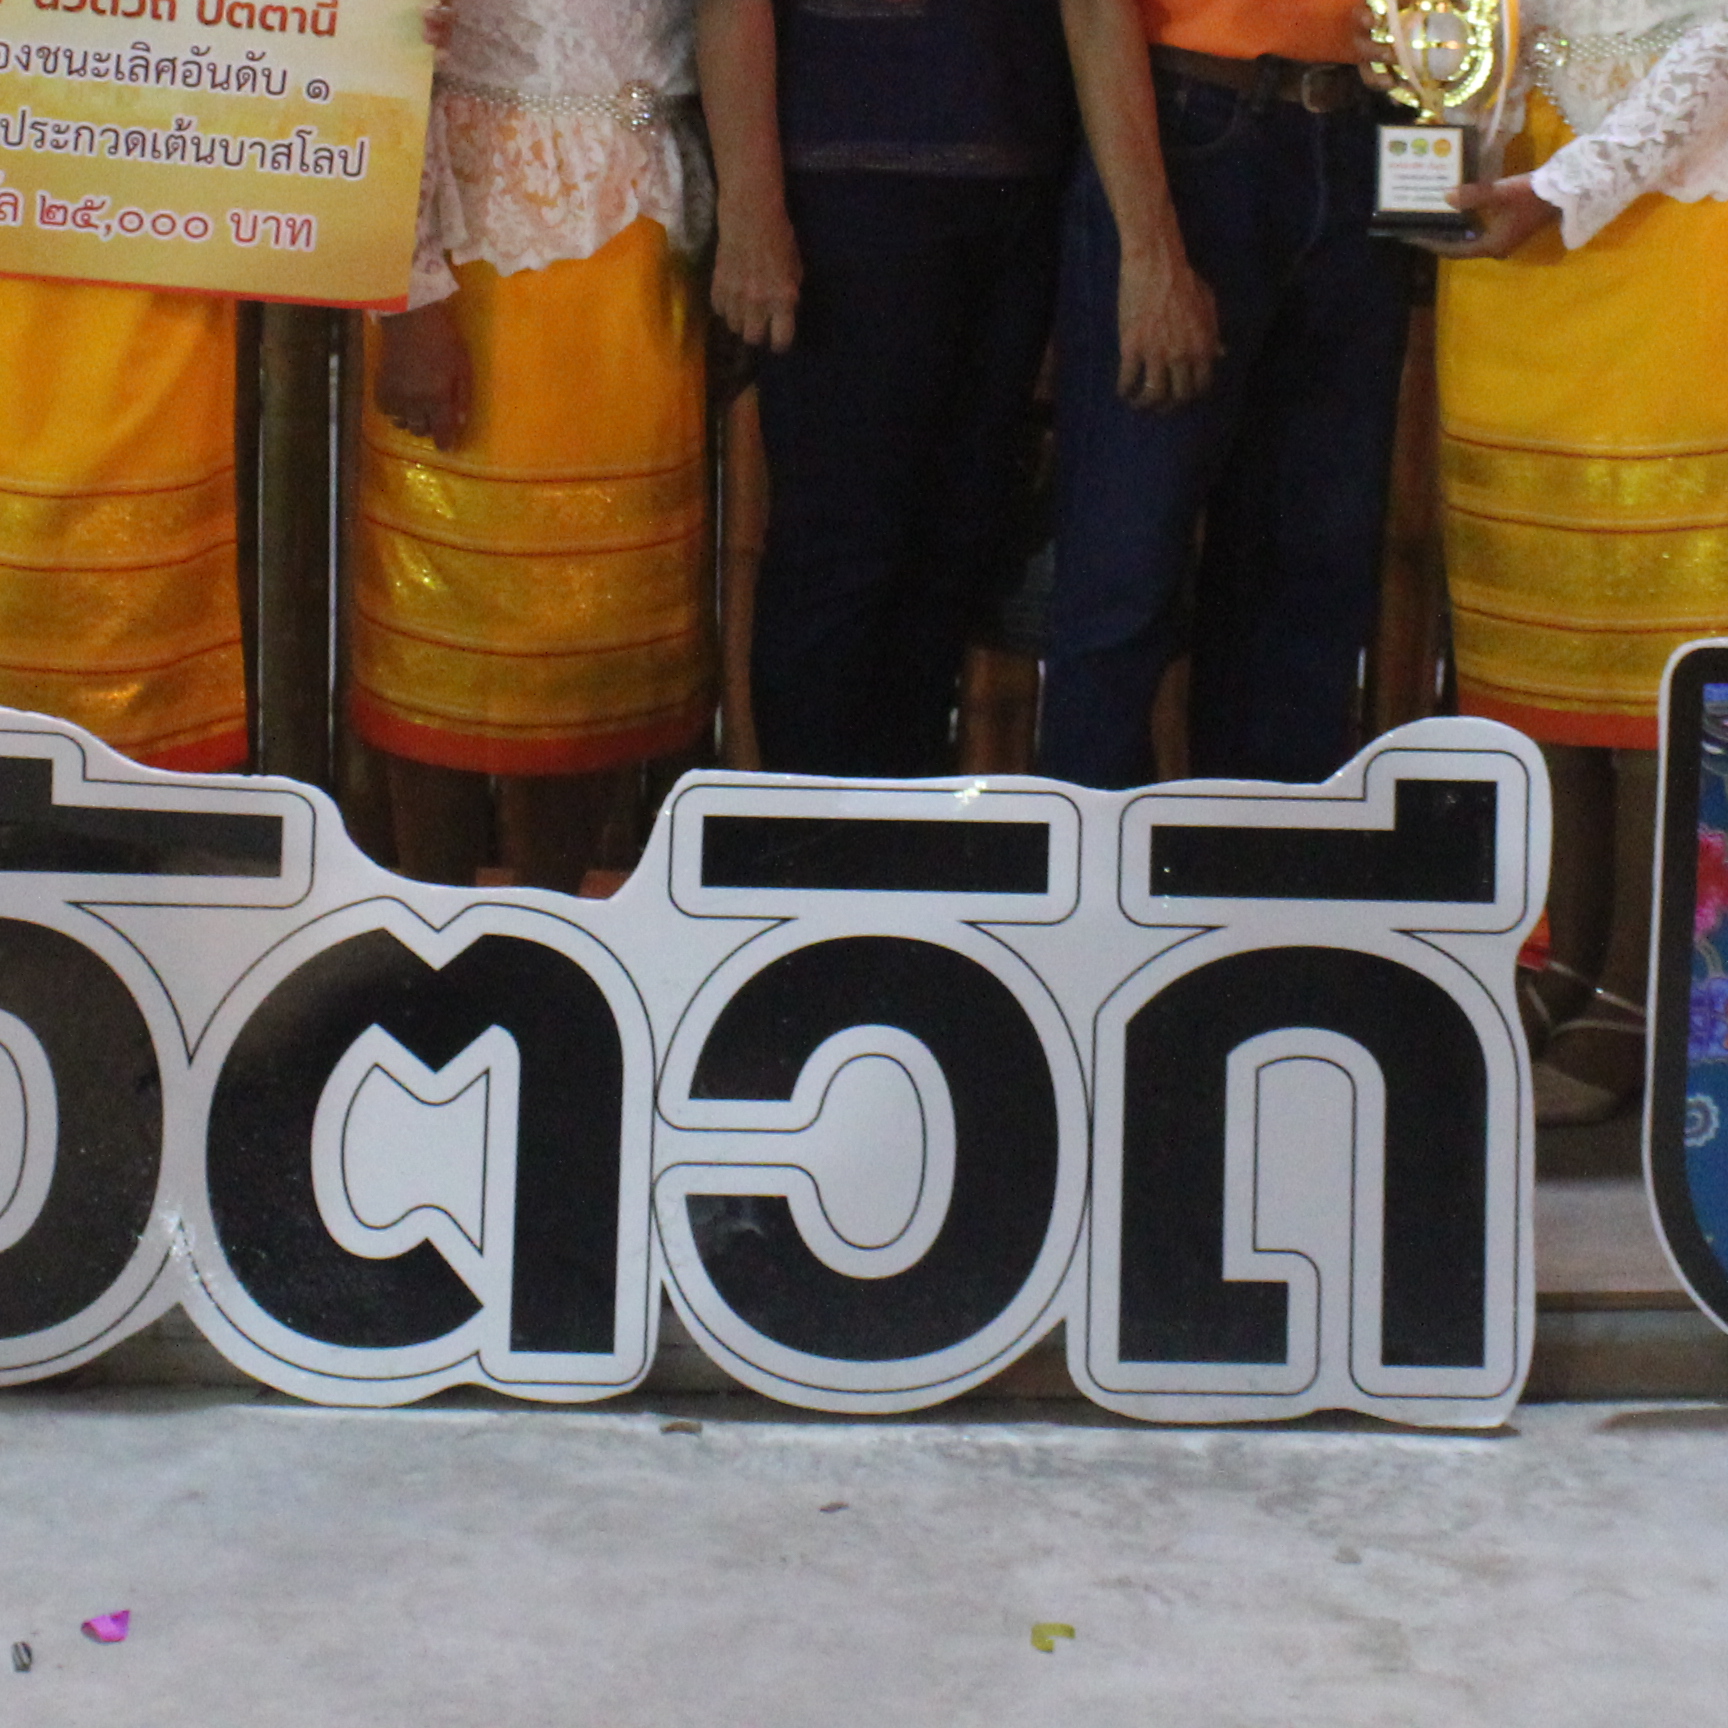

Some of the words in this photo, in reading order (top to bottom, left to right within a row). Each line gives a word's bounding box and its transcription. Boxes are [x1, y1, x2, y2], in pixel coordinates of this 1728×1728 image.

[304, 76, 331, 102] ๑
[38, 194, 210, 240] ๒๕,๐๐๐
[229, 210, 314, 249] บาท
